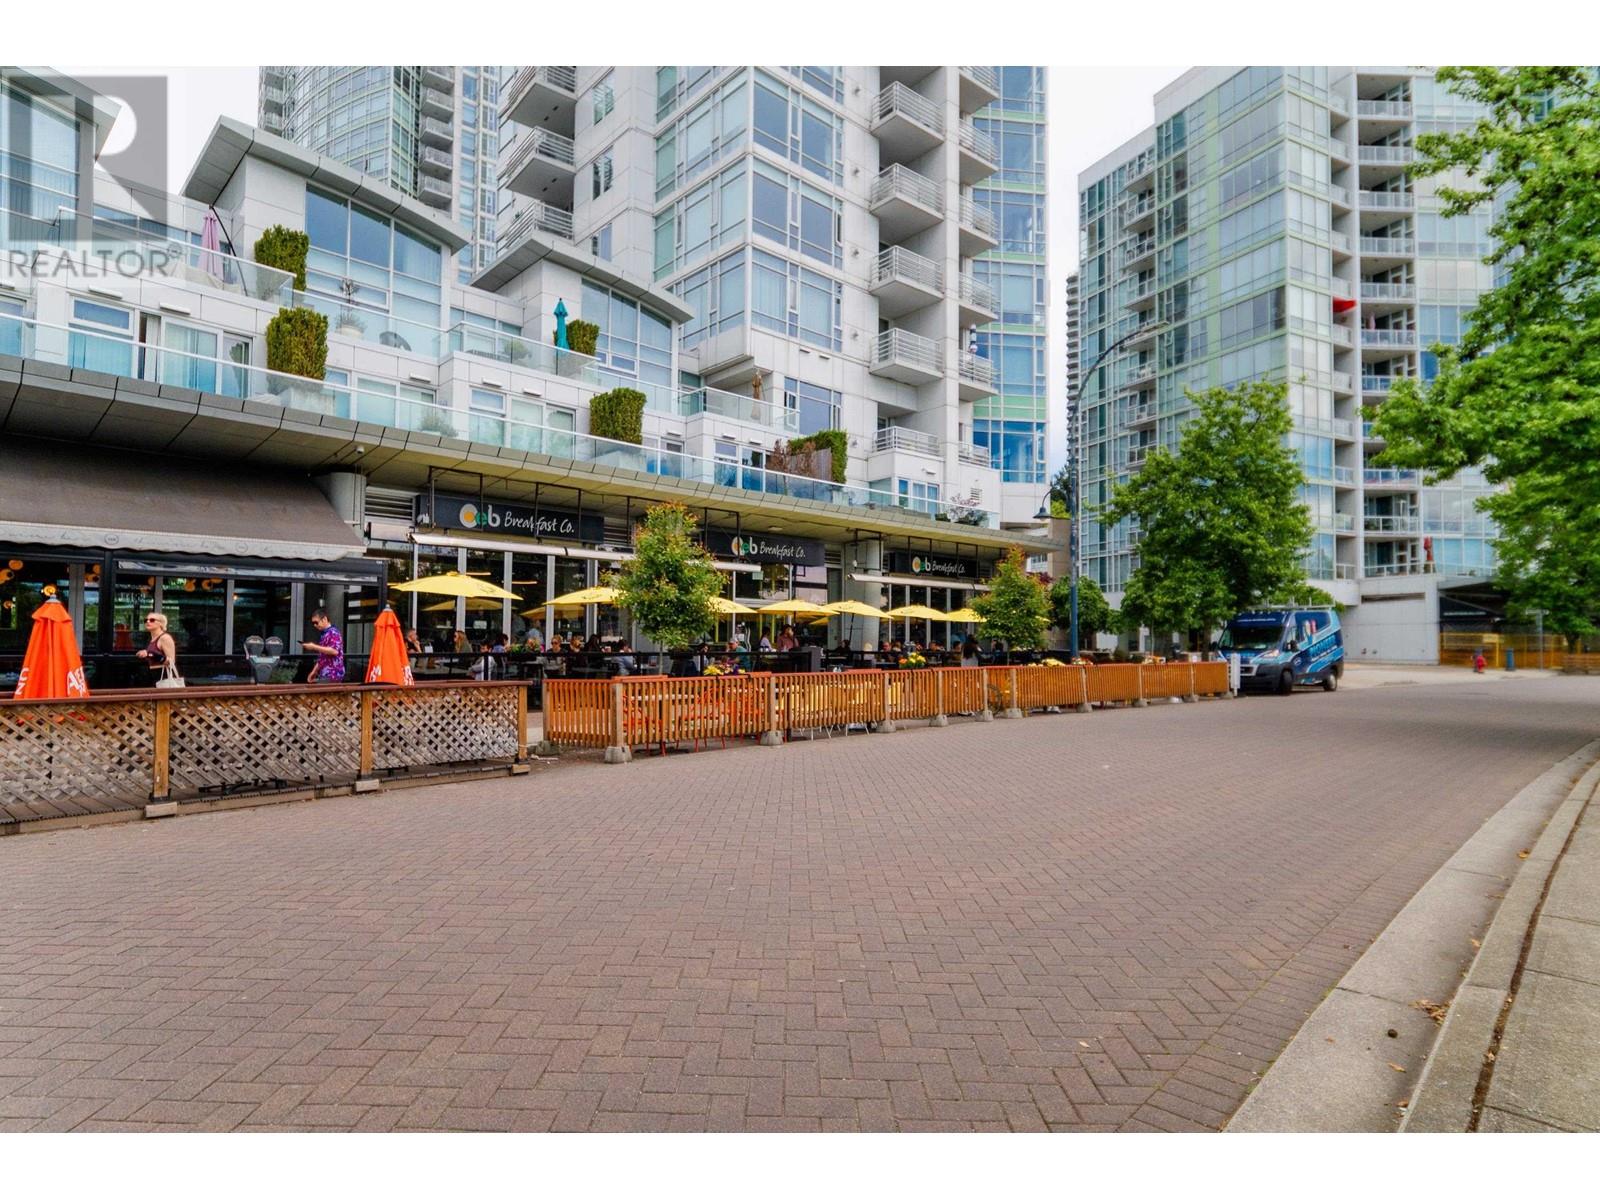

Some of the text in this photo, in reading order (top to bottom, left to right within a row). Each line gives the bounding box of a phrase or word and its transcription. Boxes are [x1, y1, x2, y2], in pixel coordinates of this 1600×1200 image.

[504, 510, 558, 535] Breakfast
[559, 519, 575, 533] Co.
[760, 541, 794, 560] Breakfast
